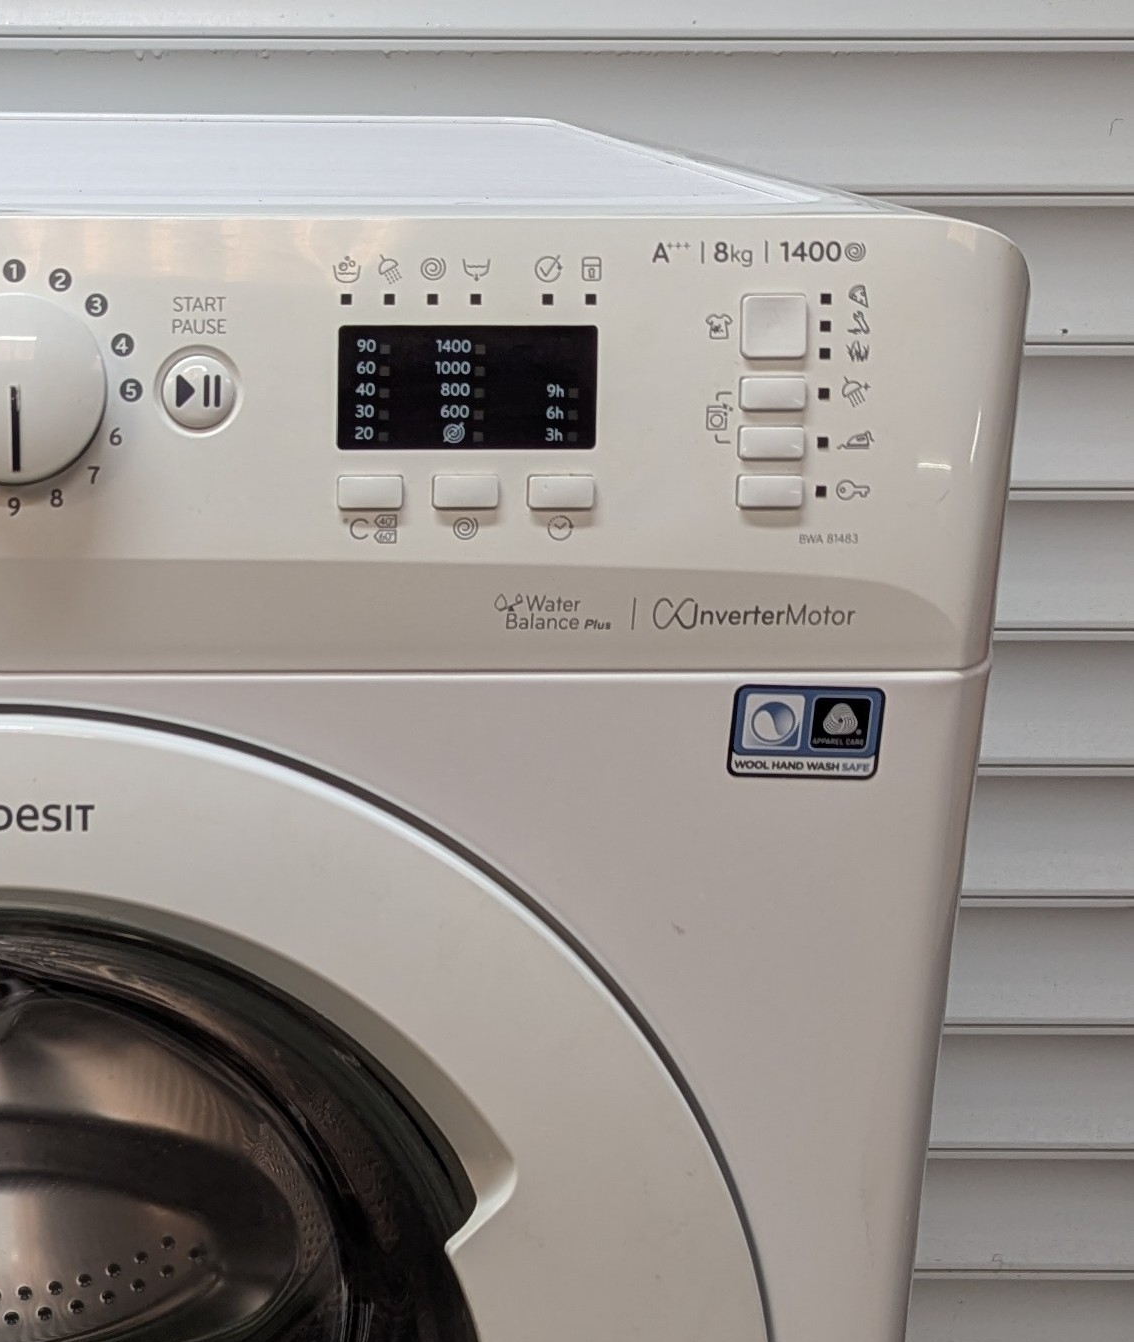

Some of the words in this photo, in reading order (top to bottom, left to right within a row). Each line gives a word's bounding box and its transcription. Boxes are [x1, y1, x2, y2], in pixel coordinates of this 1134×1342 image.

[713, 242, 753, 267] 8kg
[780, 242, 842, 262] 1400
[173, 296, 226, 312] START
[172, 318, 227, 334] PAUSE
[356, 339, 376, 353] 90
[436, 339, 472, 354] 1400
[356, 361, 376, 375] 60
[435, 362, 471, 375] 1000
[355, 383, 376, 397] 40
[440, 383, 470, 397] 800
[546, 384, 565, 398] 9h
[354, 405, 374, 419] 30
[440, 405, 470, 419] 600
[546, 406, 564, 420] 6h
[109, 428, 122, 446] 6
[354, 427, 374, 441] 20
[545, 428, 563, 442] 3h
[88, 466, 101, 484] 7
[50, 489, 64, 508] 8
[8, 497, 21, 516] 9
[799, 533, 824, 544] BWA
[526, 594, 580, 614] Water
[506, 612, 580, 631] Balance
[584, 618, 612, 632] Plus
[734, 760, 770, 770] WOOL
[772, 760, 804, 770] HAND
[806, 762, 840, 772] WASH
[842, 762, 871, 772] SAFE
